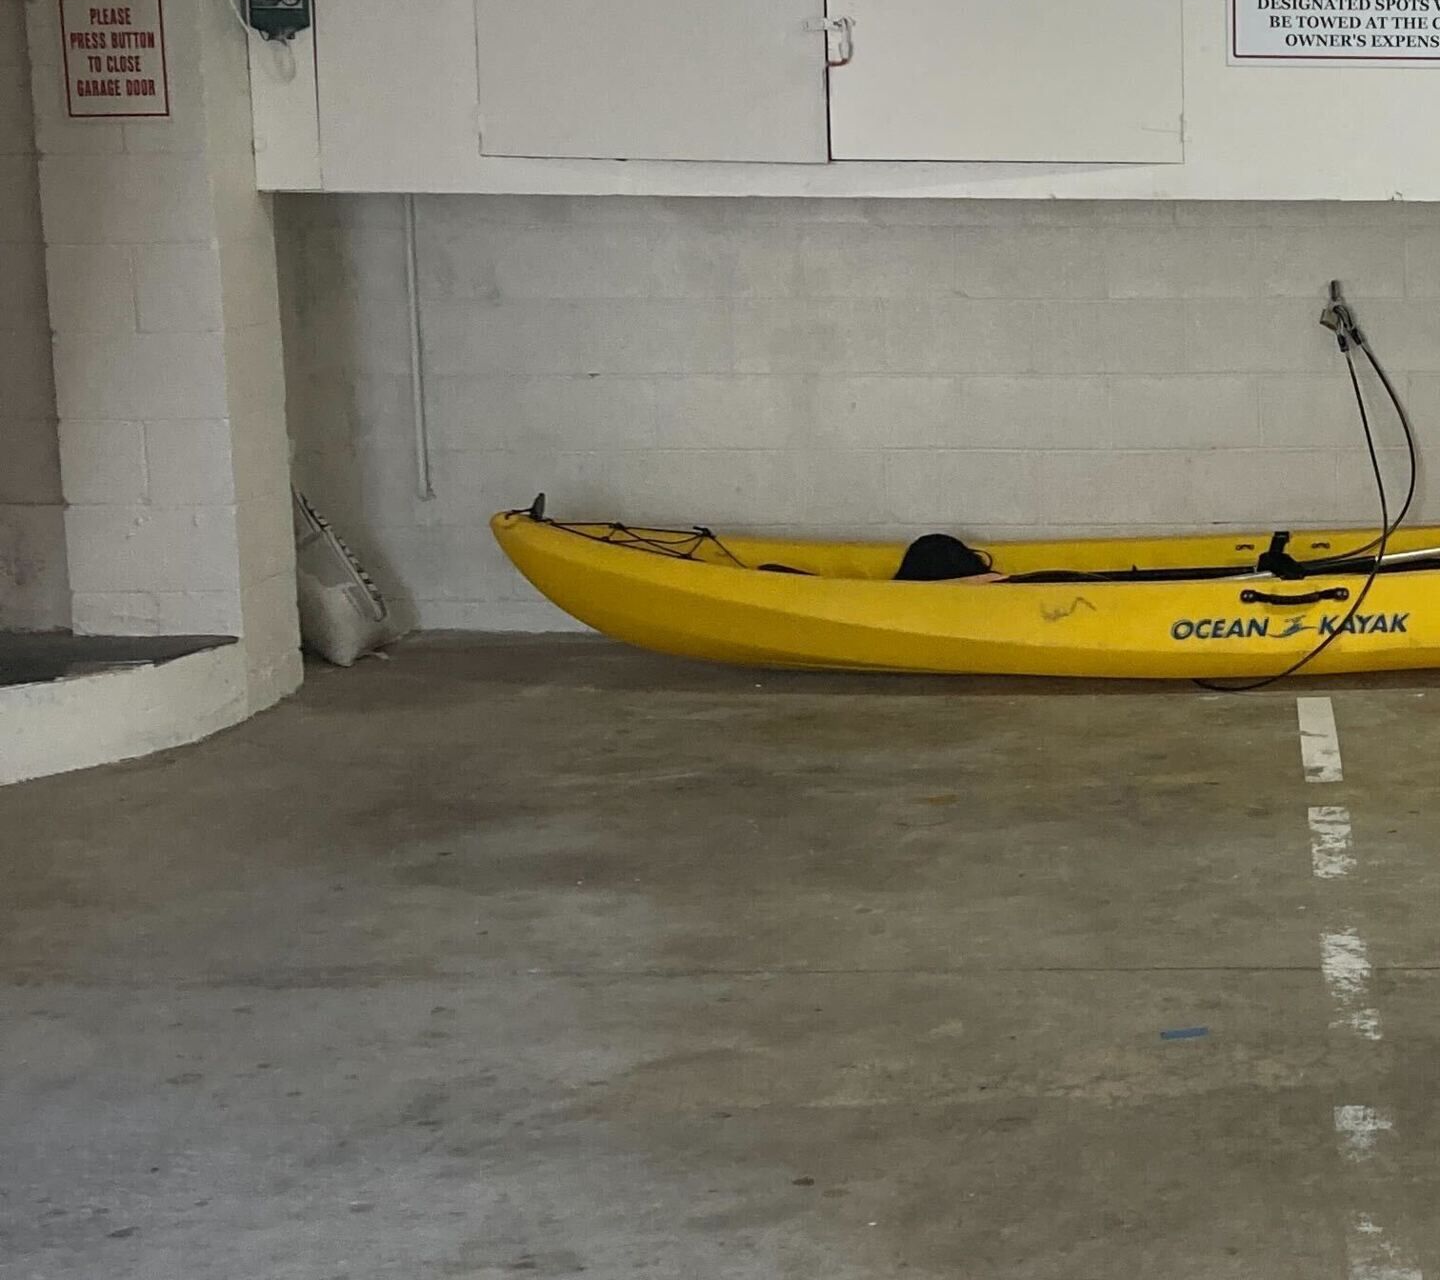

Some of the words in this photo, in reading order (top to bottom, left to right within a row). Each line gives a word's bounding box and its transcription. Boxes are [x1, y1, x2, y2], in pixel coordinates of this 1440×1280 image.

[89, 7, 132, 25] PLEASE
[1269, 15, 1292, 28] BE
[1296, 15, 1361, 29] TOWED
[1365, 16, 1388, 29] AT
[1391, 17, 1428, 30] THE
[70, 31, 106, 50] PRESS
[111, 31, 155, 49] BUTTON
[1285, 33, 1367, 48] OWNER'S
[87, 55, 102, 73] TO
[107, 55, 141, 73] CLOSE
[77, 79, 121, 97] GARAGE
[126, 78, 155, 96] DOOR
[1171, 616, 1269, 640] OCEAN
[1318, 613, 1410, 635] KAYAK
